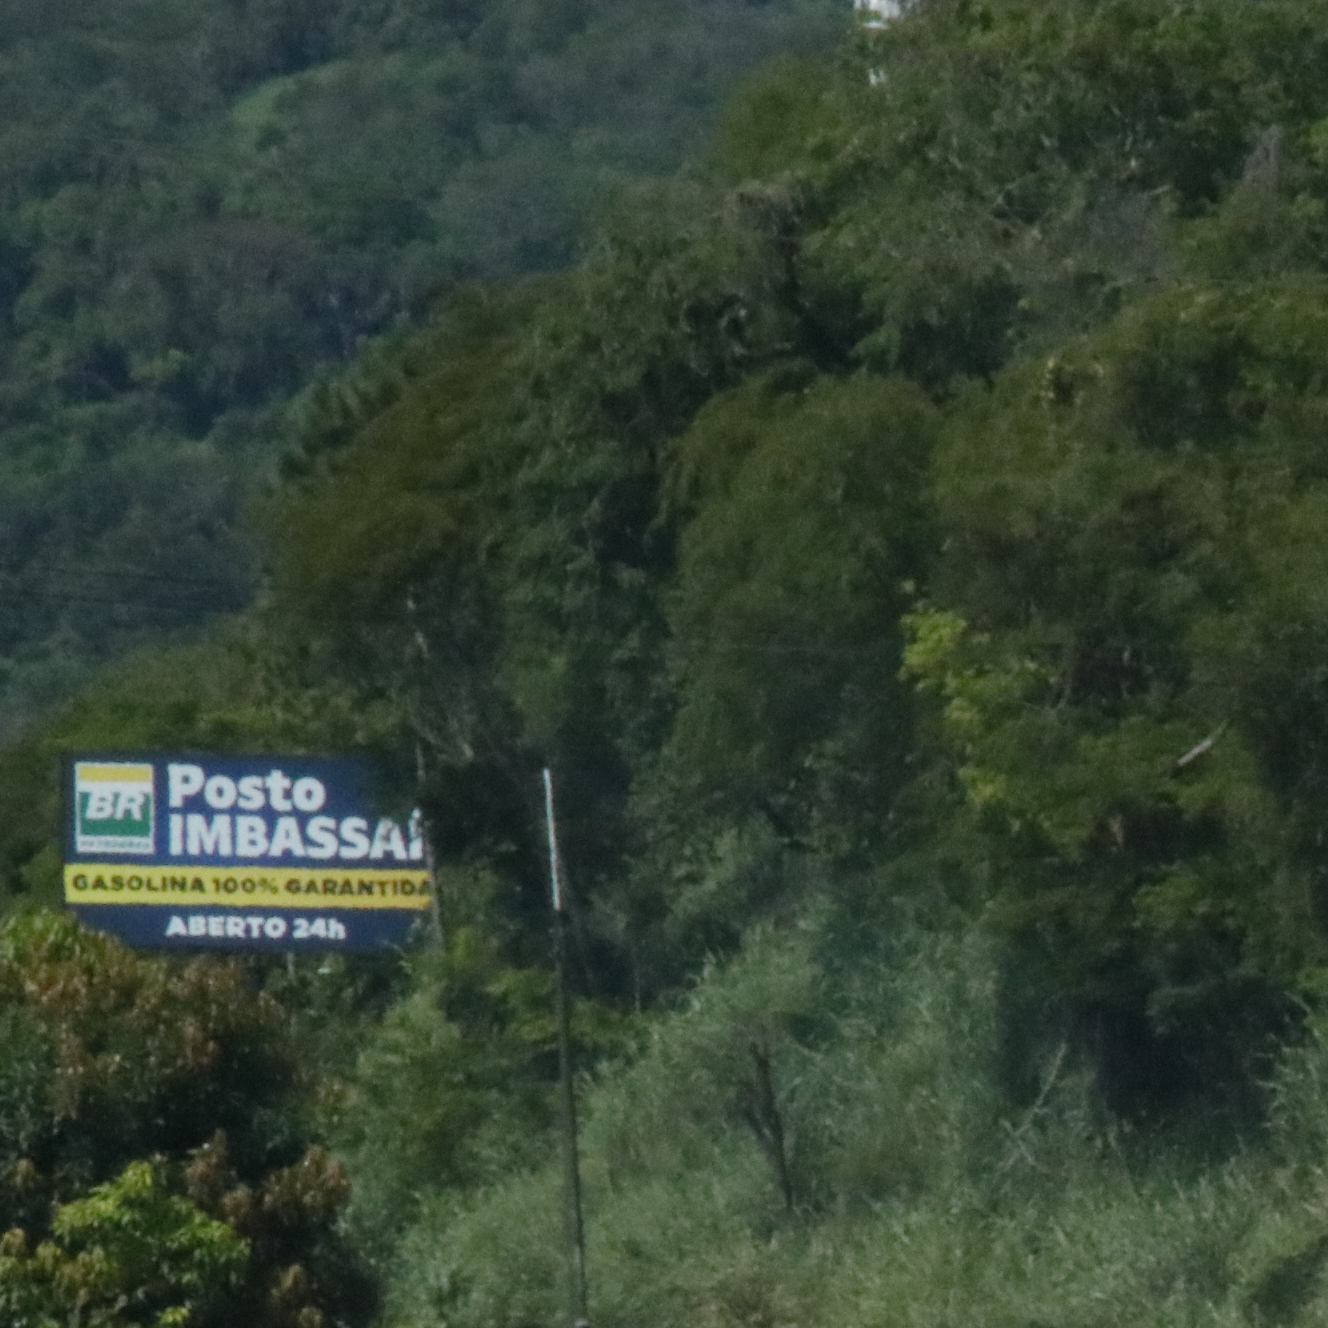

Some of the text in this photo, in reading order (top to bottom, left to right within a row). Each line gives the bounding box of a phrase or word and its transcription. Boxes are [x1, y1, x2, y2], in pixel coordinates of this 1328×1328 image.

[167, 762, 327, 813] Posto
[85, 788, 145, 821] BR
[71, 873, 206, 894] GASOLINA
[212, 877, 279, 896] 100%
[165, 915, 347, 941] ABERTO 24h
